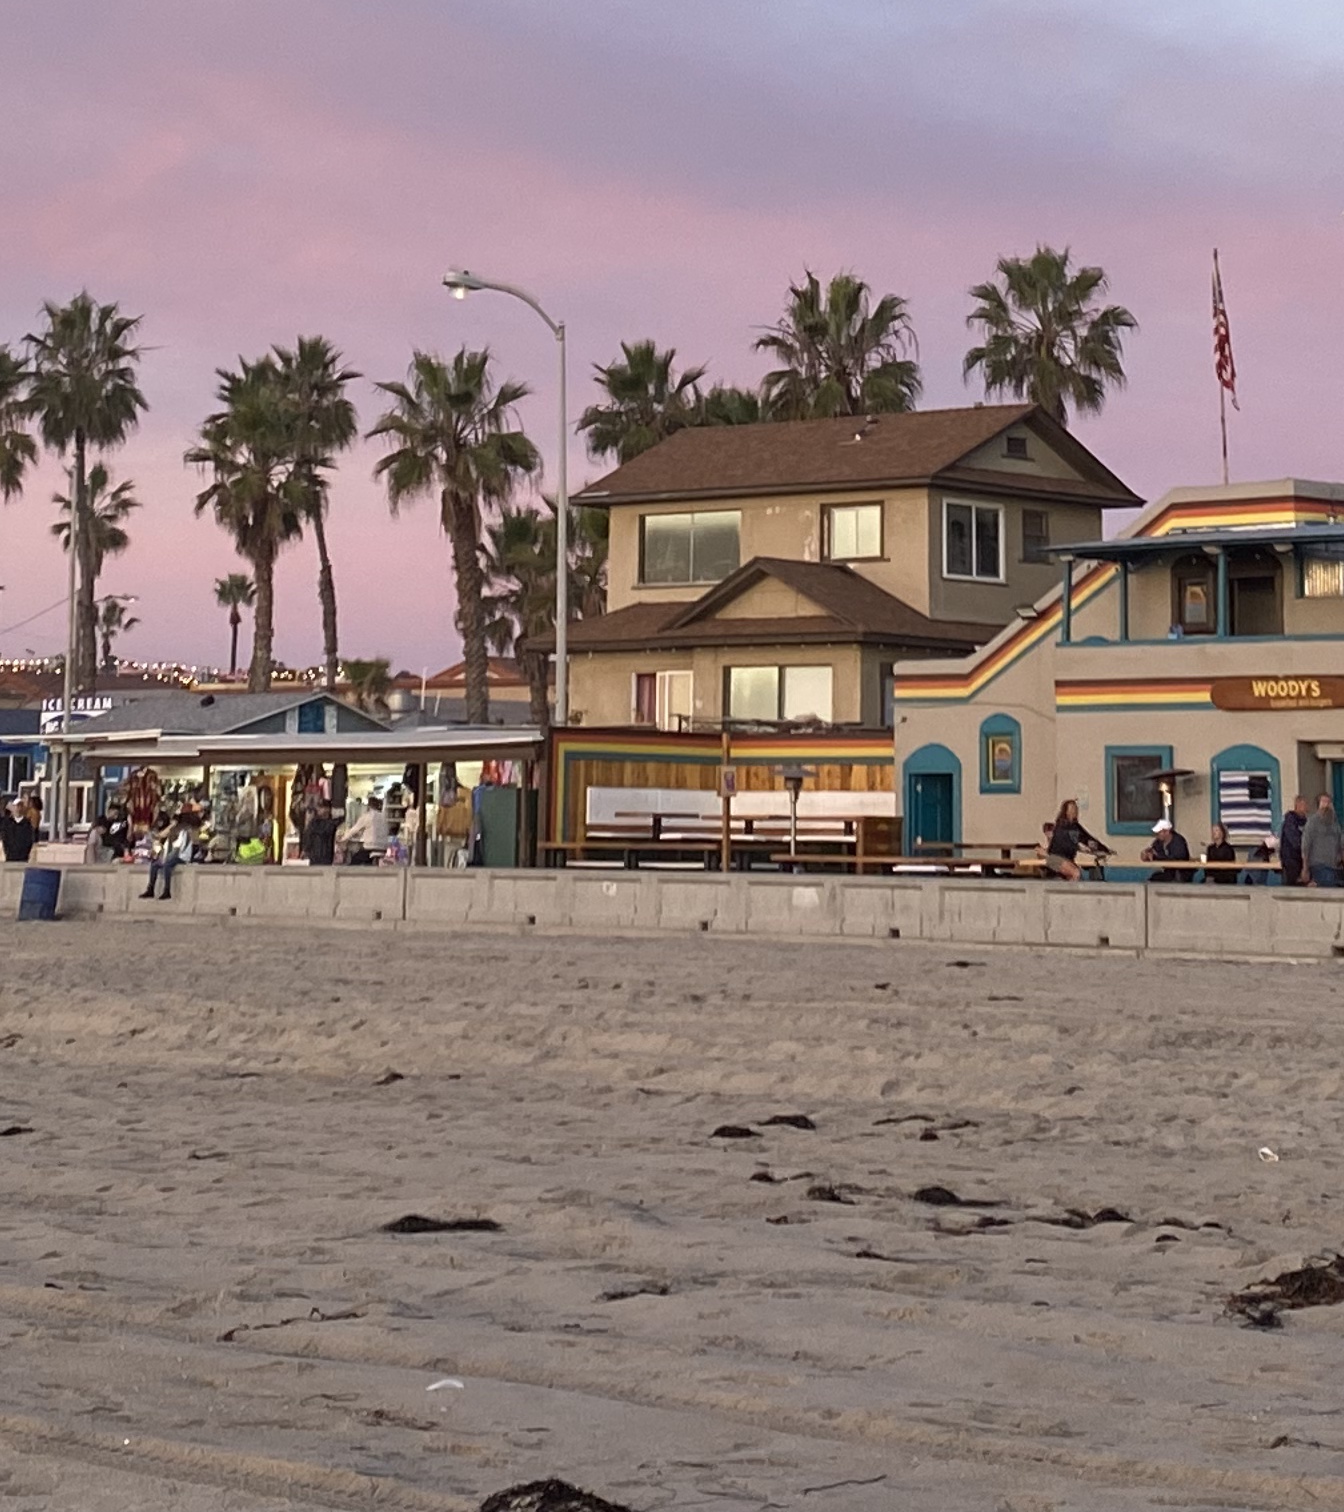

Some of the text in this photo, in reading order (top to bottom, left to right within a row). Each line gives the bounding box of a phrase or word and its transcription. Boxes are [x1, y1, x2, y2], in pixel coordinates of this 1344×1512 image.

[1251, 680, 1321, 698] WOODY'S
[42, 696, 112, 711] ICE CREAM
